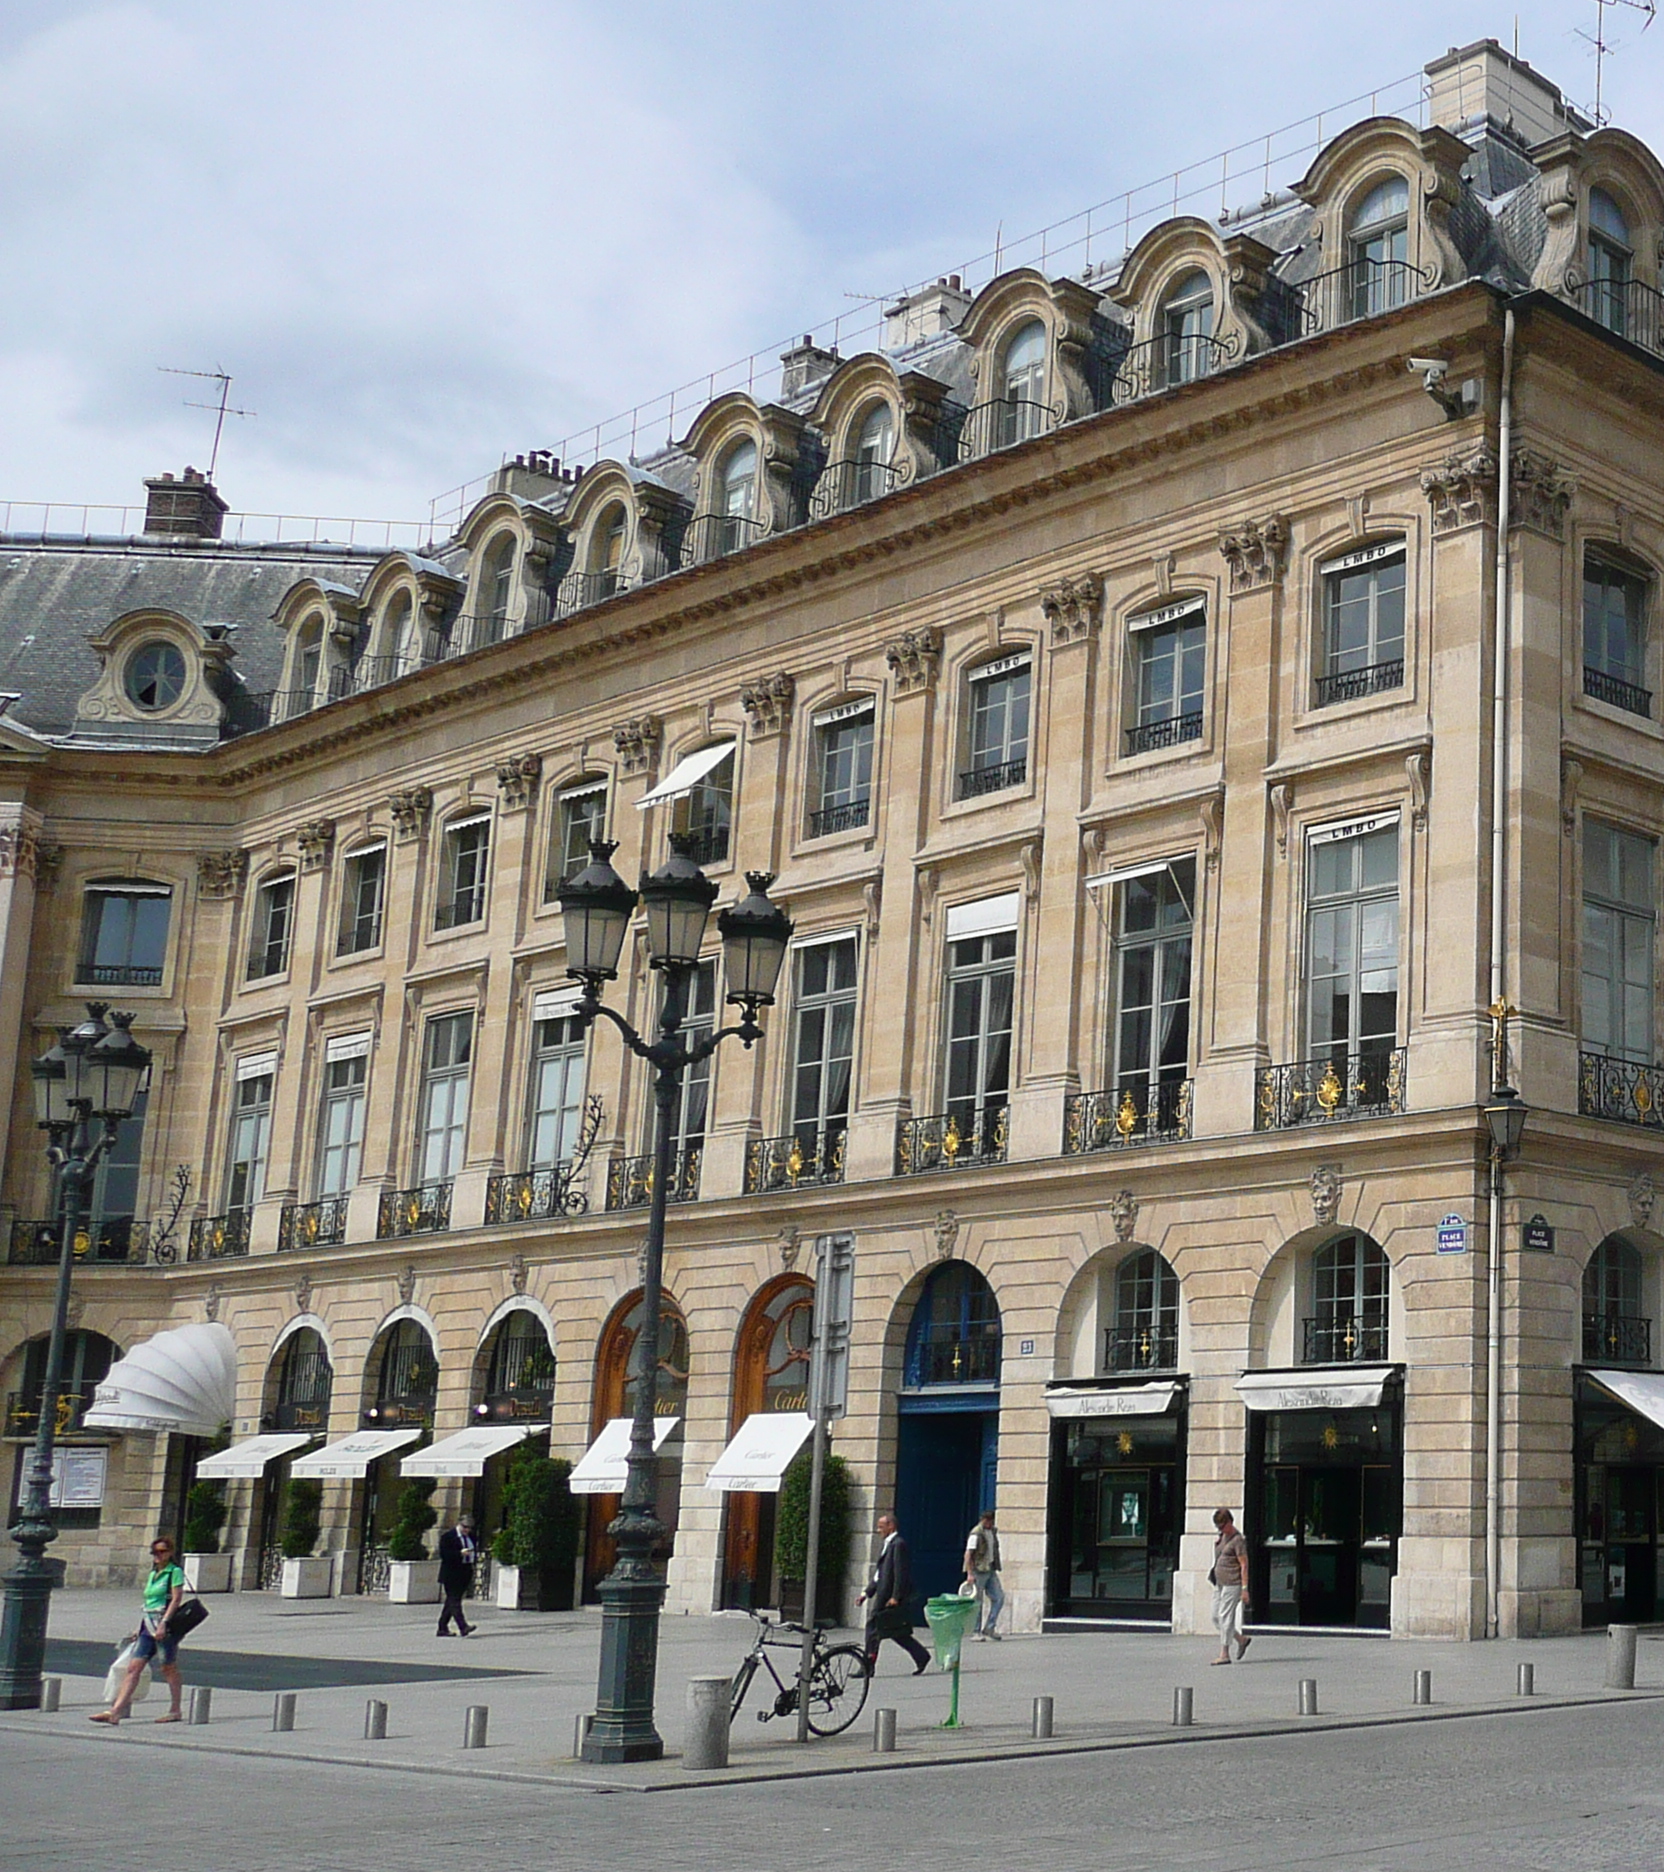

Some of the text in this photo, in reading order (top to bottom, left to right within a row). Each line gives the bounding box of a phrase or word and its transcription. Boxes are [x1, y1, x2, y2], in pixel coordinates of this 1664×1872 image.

[1342, 546, 1386, 567] LMBO
[1148, 606, 1186, 625] LMBO
[986, 656, 1020, 675] LMBO
[1331, 820, 1377, 839] LMBO
